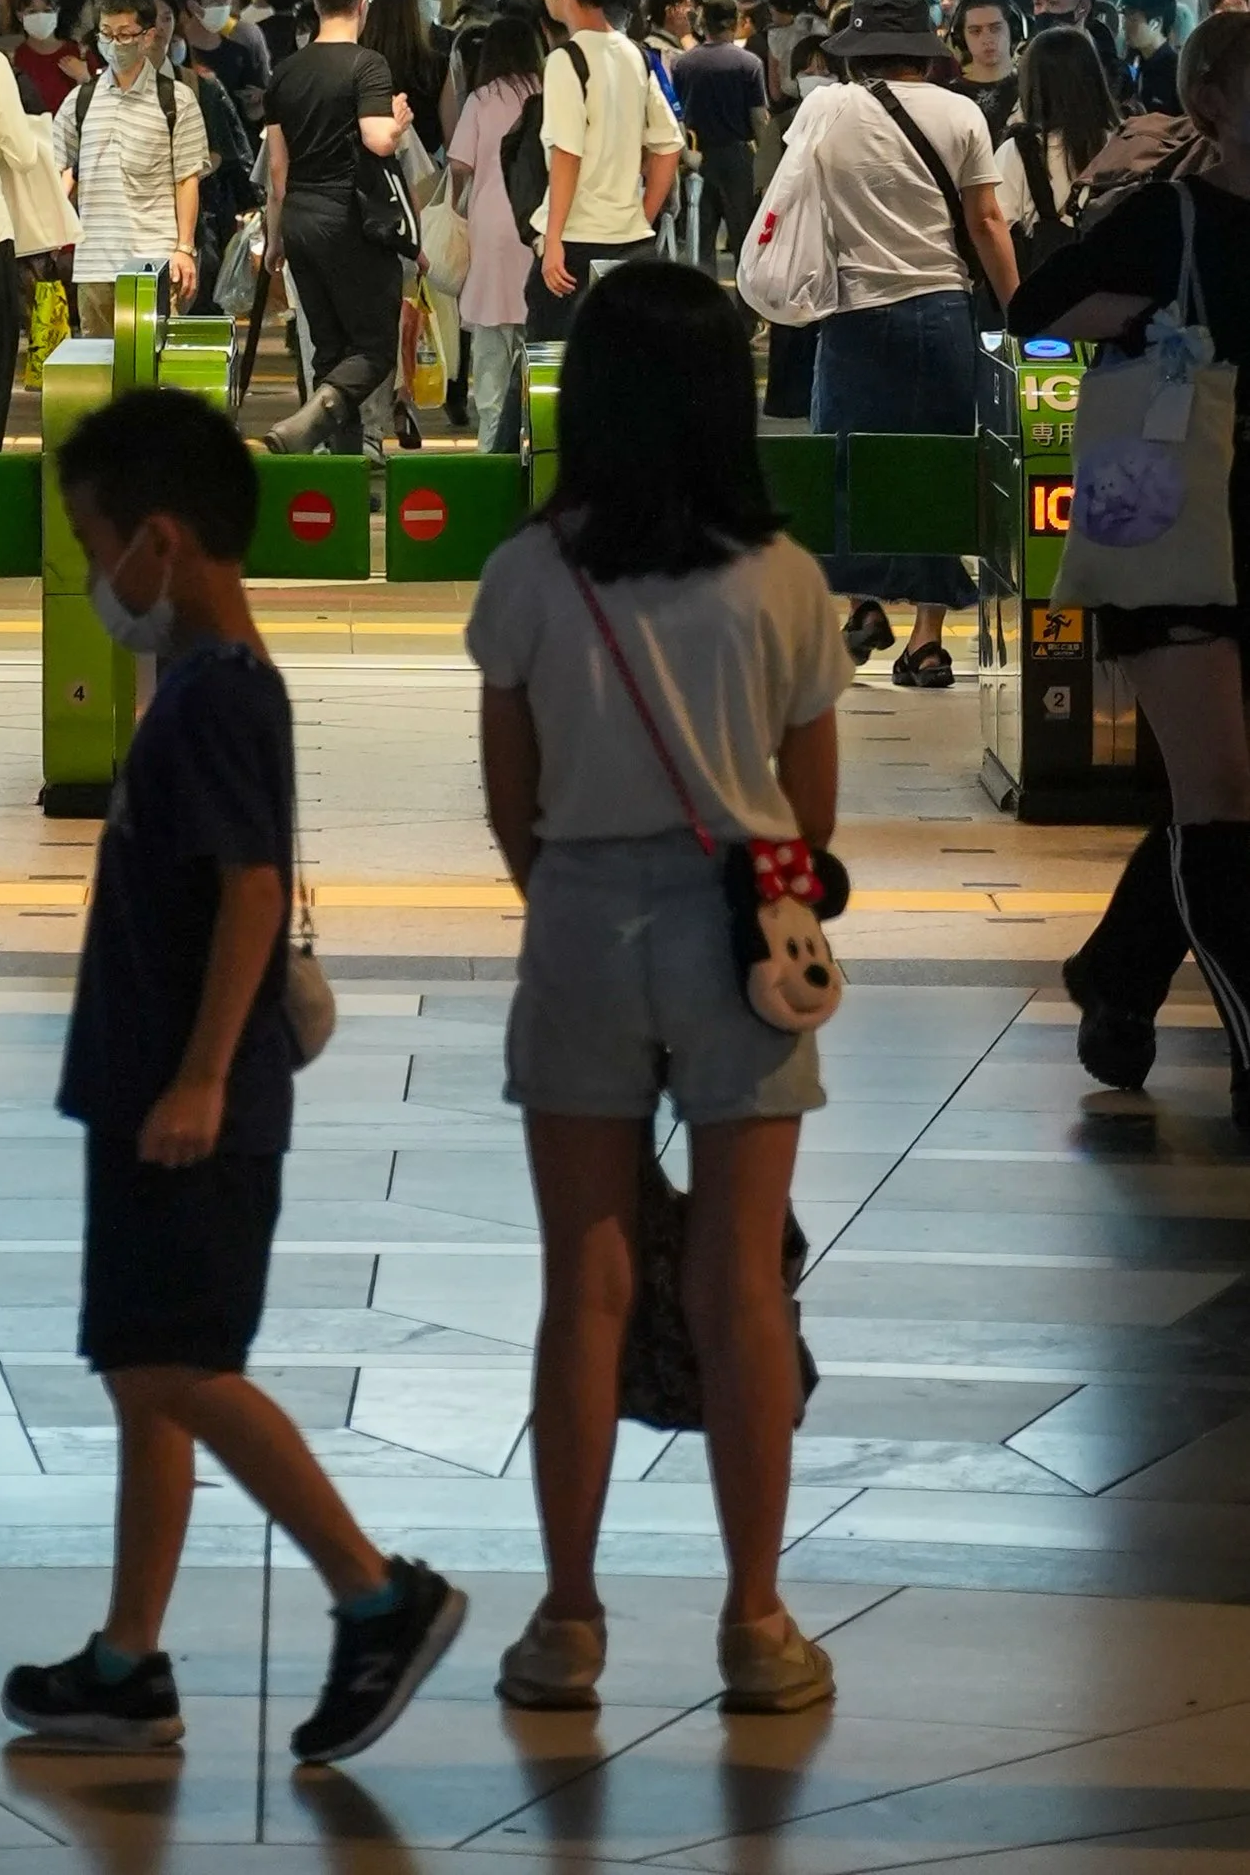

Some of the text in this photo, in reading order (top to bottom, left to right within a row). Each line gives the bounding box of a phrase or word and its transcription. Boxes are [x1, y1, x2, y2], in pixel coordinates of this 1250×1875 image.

[1025, 375, 1080, 411] IC
[74, 686, 85, 701] 4
[1054, 693, 1064, 707] 2
